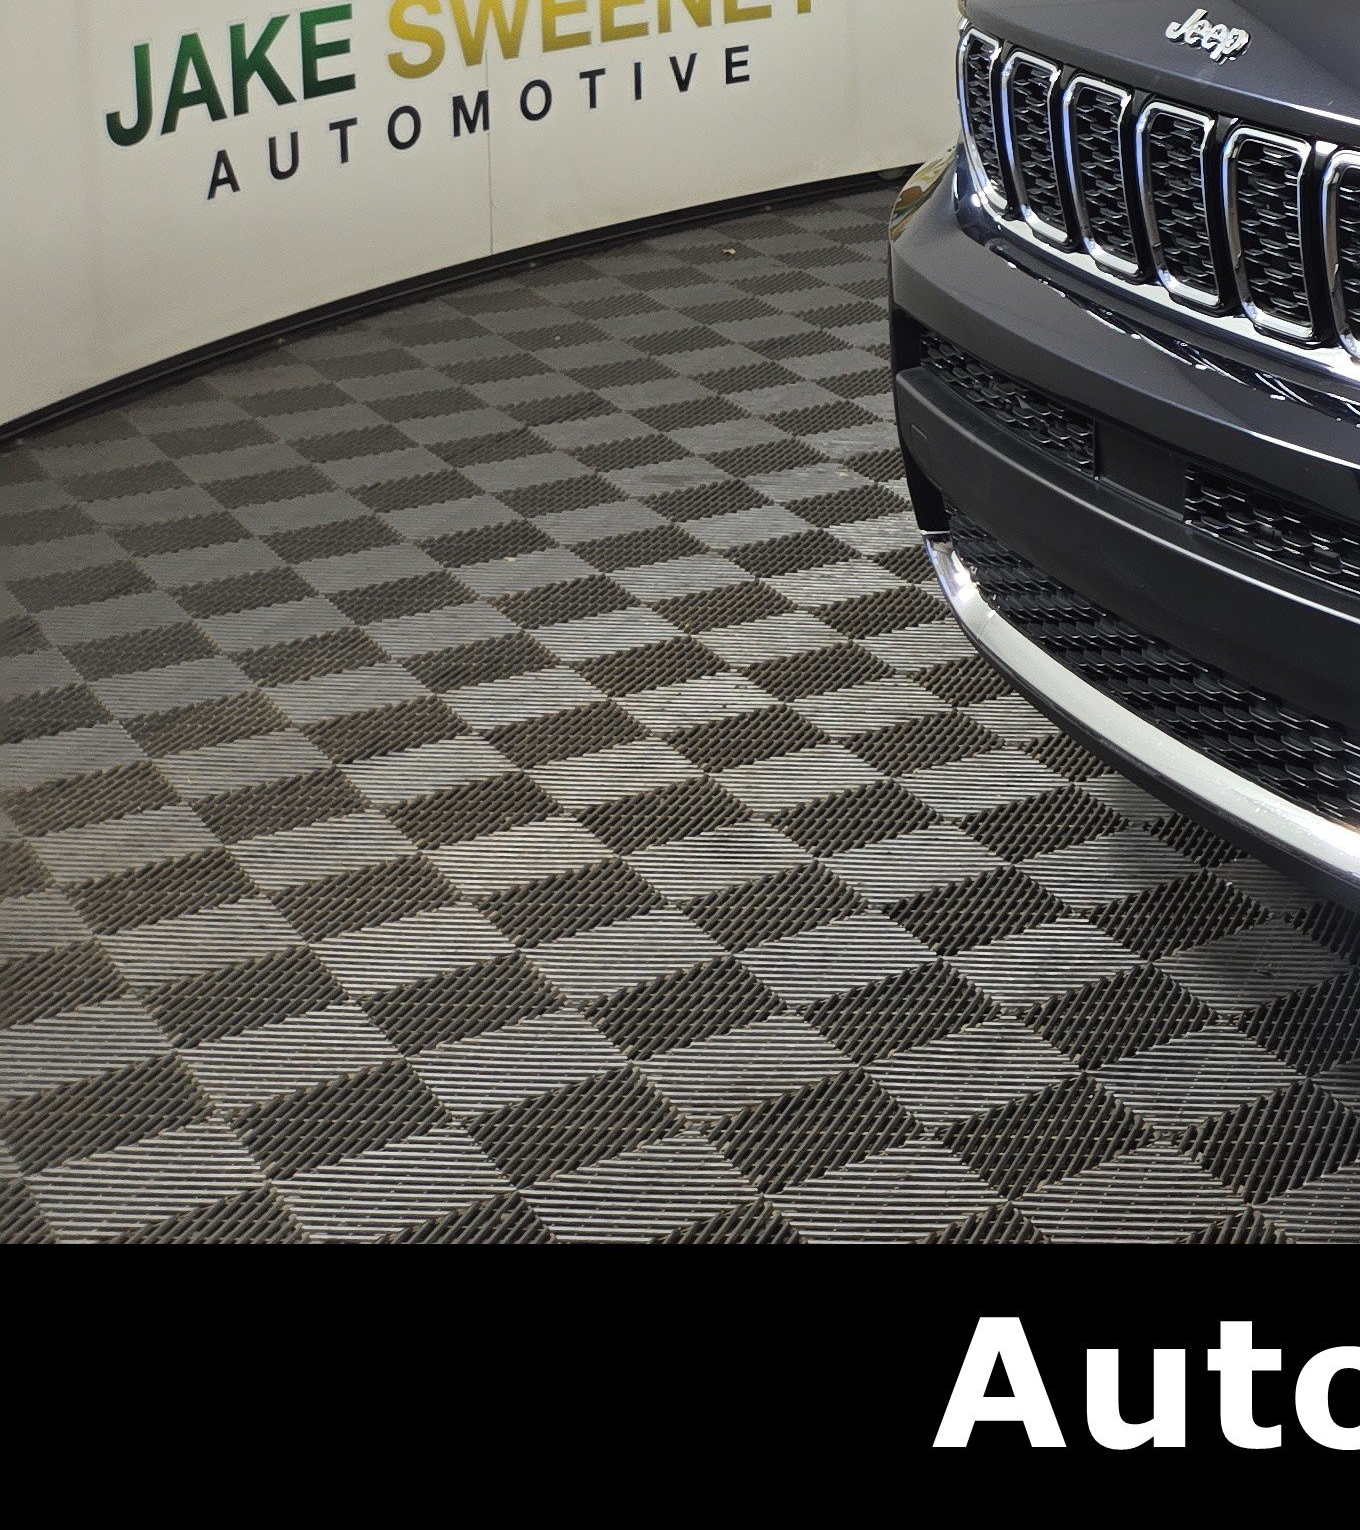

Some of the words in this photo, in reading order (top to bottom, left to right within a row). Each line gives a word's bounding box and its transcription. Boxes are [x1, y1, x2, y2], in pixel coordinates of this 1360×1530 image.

[105, 2, 357, 148] JAKE
[1165, 8, 1251, 62] Jeep
[206, 45, 752, 200] AUTOMOTIVE
